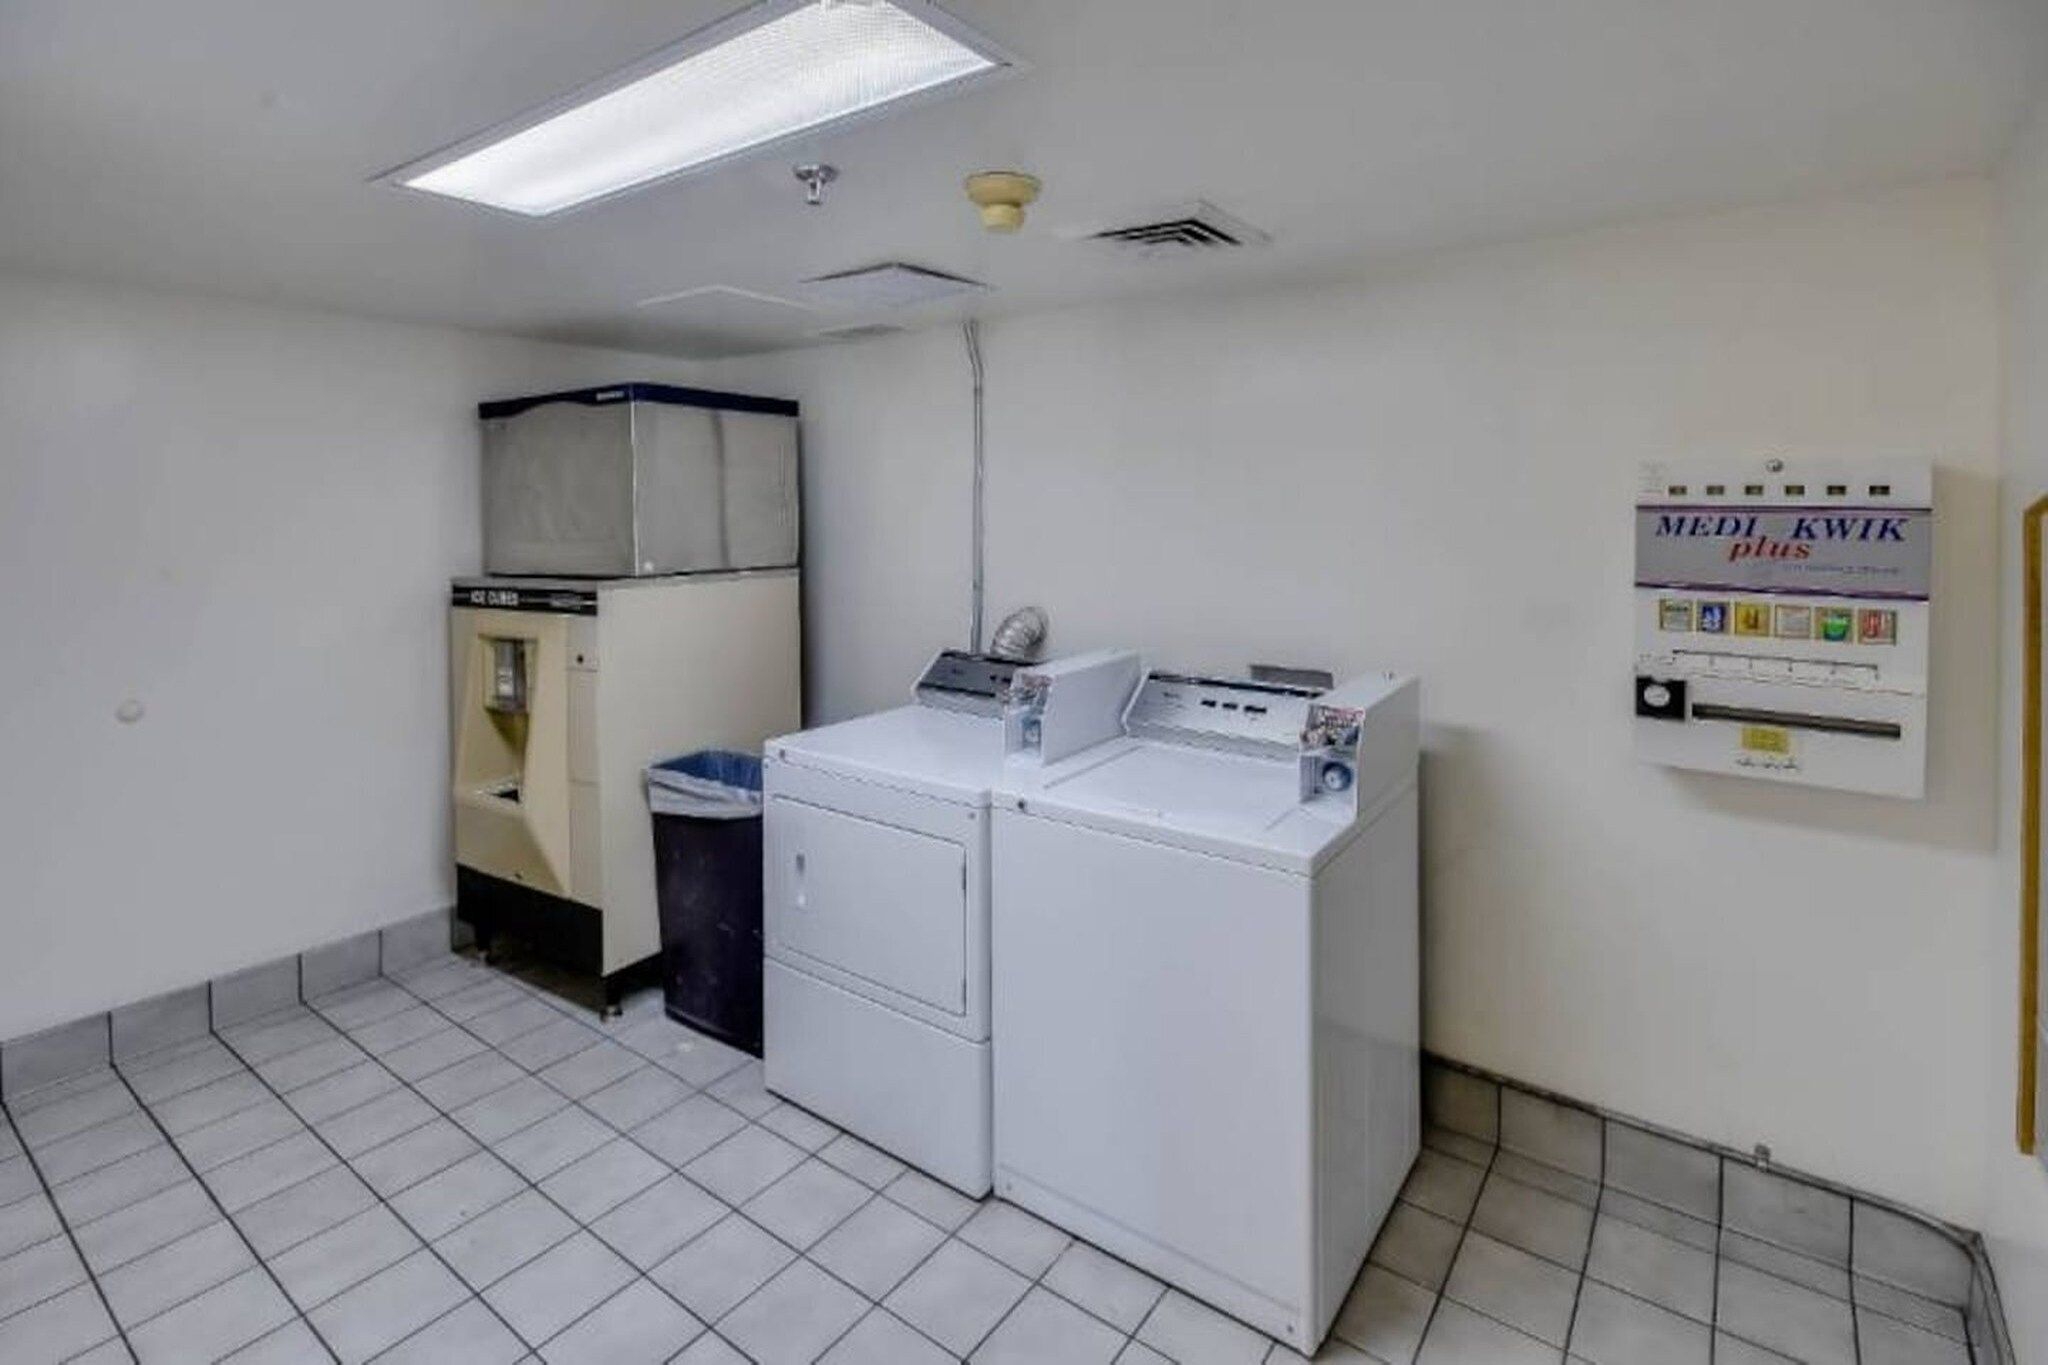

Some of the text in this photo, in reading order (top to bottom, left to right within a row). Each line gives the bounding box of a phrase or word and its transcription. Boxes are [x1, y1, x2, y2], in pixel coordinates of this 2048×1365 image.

[1656, 515, 1909, 541] MEDI KWIK
[1728, 536, 1811, 562] plus
